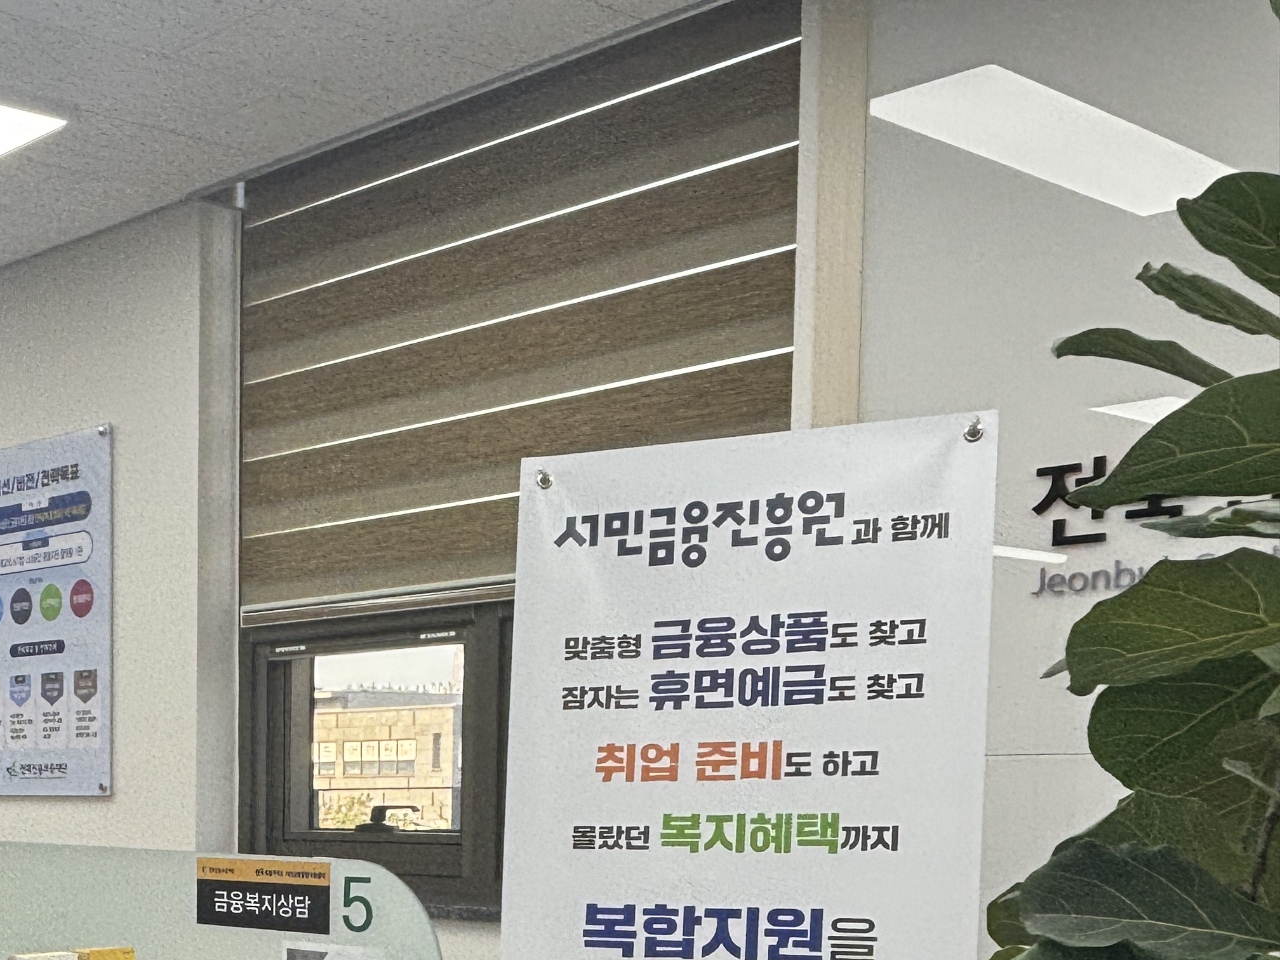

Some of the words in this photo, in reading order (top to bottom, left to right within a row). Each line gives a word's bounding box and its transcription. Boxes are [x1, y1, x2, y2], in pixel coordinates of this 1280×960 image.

[553, 490, 882, 568] 서민금융진흥원과
[890, 512, 949, 542] 함께
[1031, 560, 1144, 597] Jeonb
[563, 634, 643, 661] 맞춤형
[651, 611, 860, 661] 금융상품도
[868, 618, 928, 647] 찾고
[561, 685, 640, 711] 잠자는
[648, 664, 856, 711] 휴면예금도
[866, 673, 926, 701] 찾고
[595, 742, 680, 783] 취업
[694, 740, 812, 783] 준비도
[823, 750, 881, 777] 하고
[571, 825, 651, 852] 몰랐던
[659, 812, 900, 855] 복지혜택까지
[213, 889, 312, 919] 금융복지상담
[342, 876, 374, 933] 5
